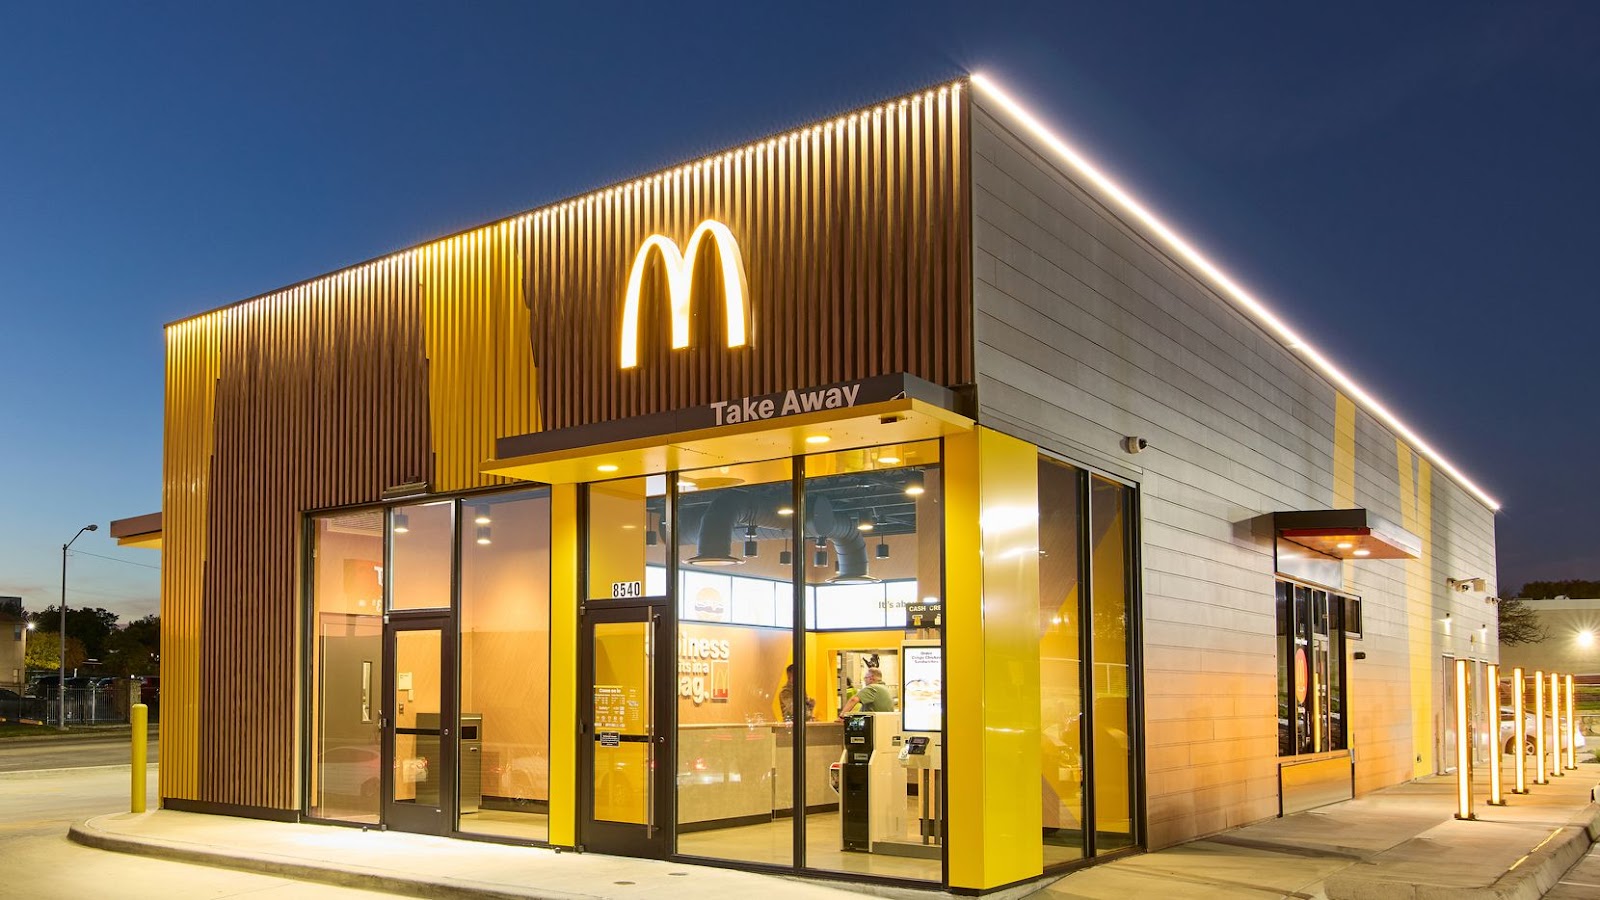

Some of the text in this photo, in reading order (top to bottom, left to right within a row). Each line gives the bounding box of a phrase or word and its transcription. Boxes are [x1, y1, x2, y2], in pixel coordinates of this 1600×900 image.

[710, 383, 861, 426] Take Away
[613, 582, 640, 598] 8540
[678, 631, 730, 659] iness
[678, 676, 709, 704] ag.
